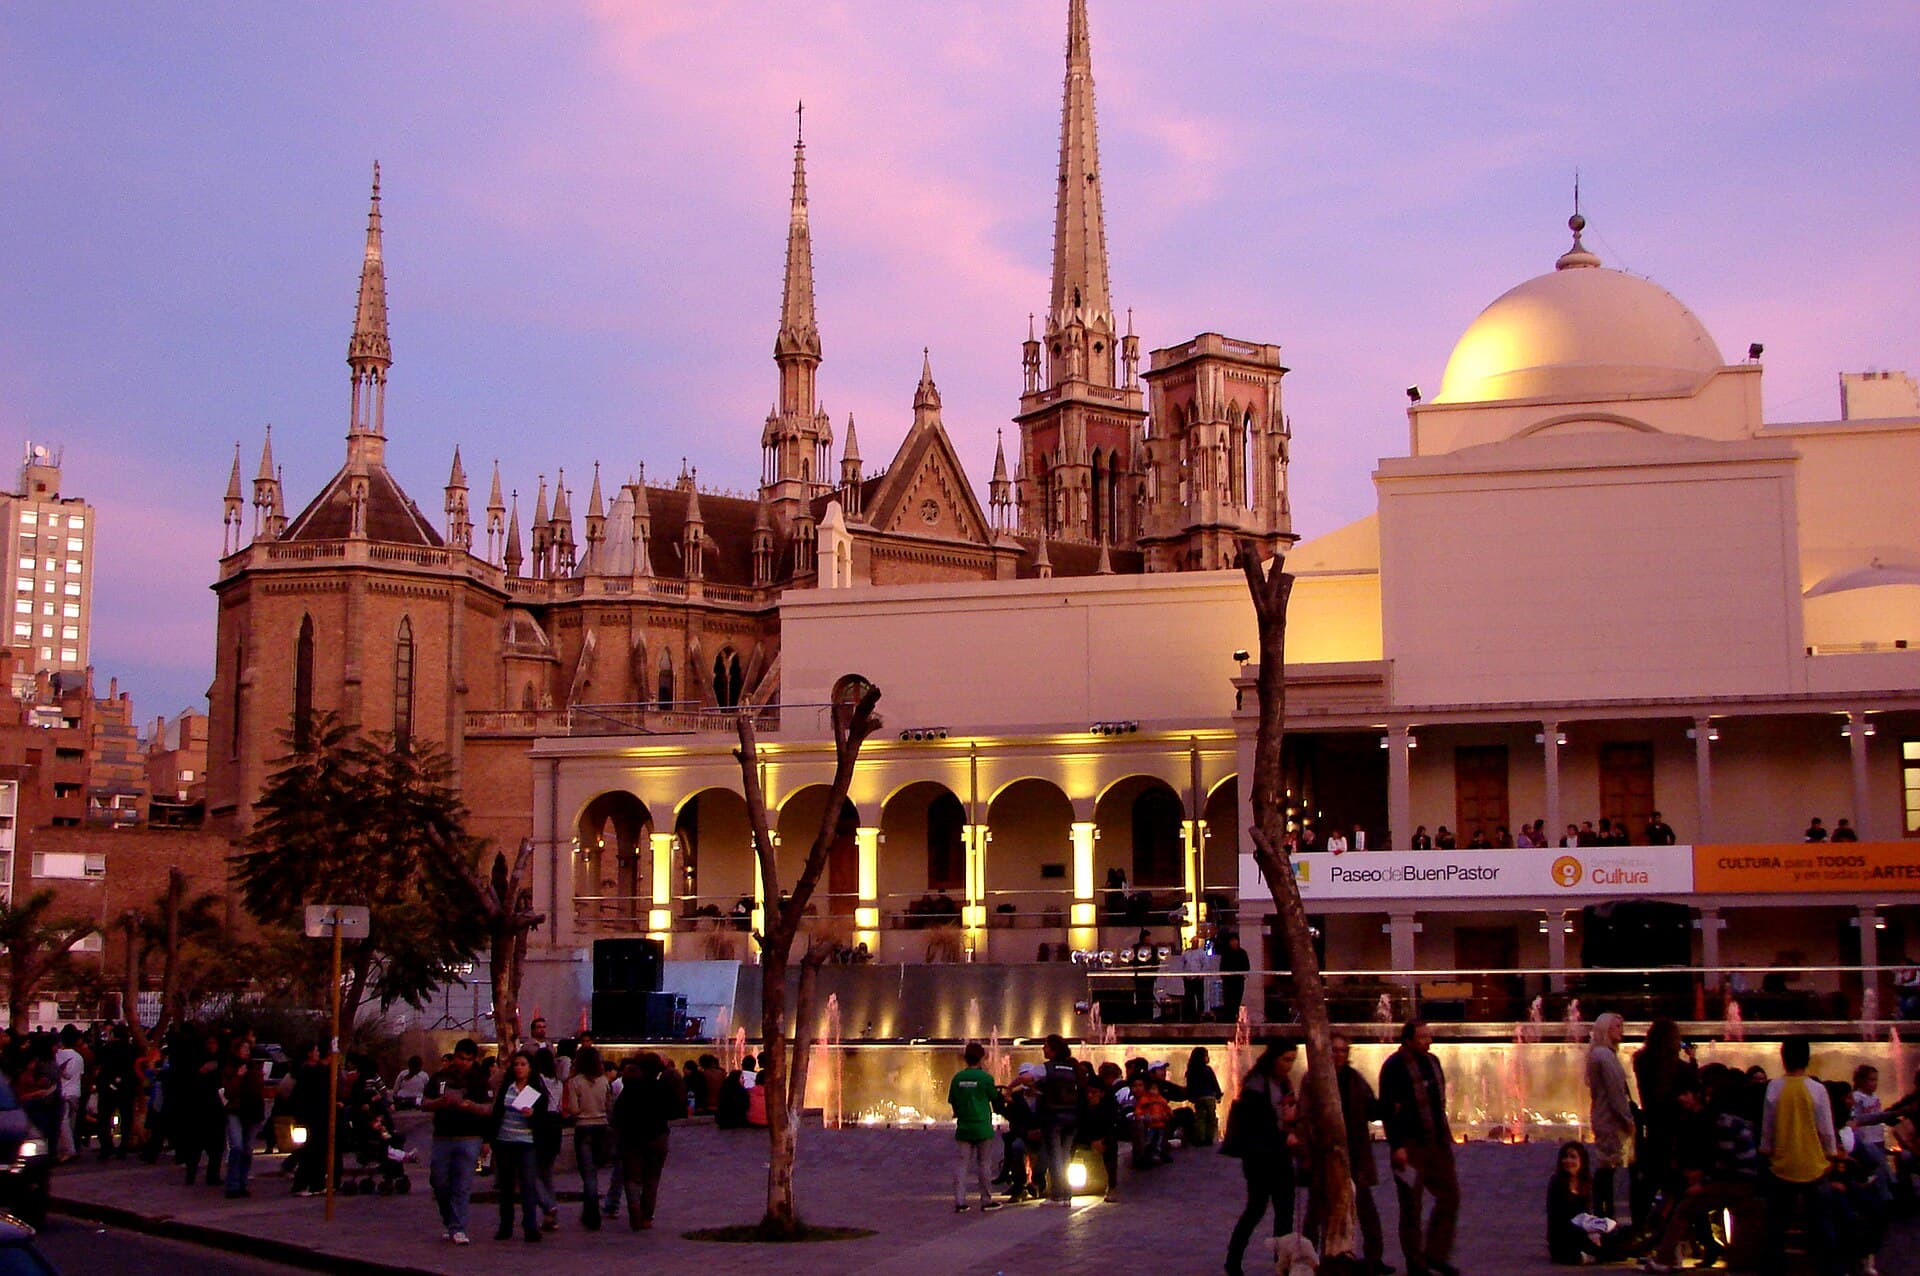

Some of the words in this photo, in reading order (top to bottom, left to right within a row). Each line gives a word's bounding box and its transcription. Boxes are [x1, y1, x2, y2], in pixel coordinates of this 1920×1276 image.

[1718, 857, 1781, 869] CULTURA
[1817, 855, 1866, 867] TODOS
[1592, 868, 1648, 884] Cultura
